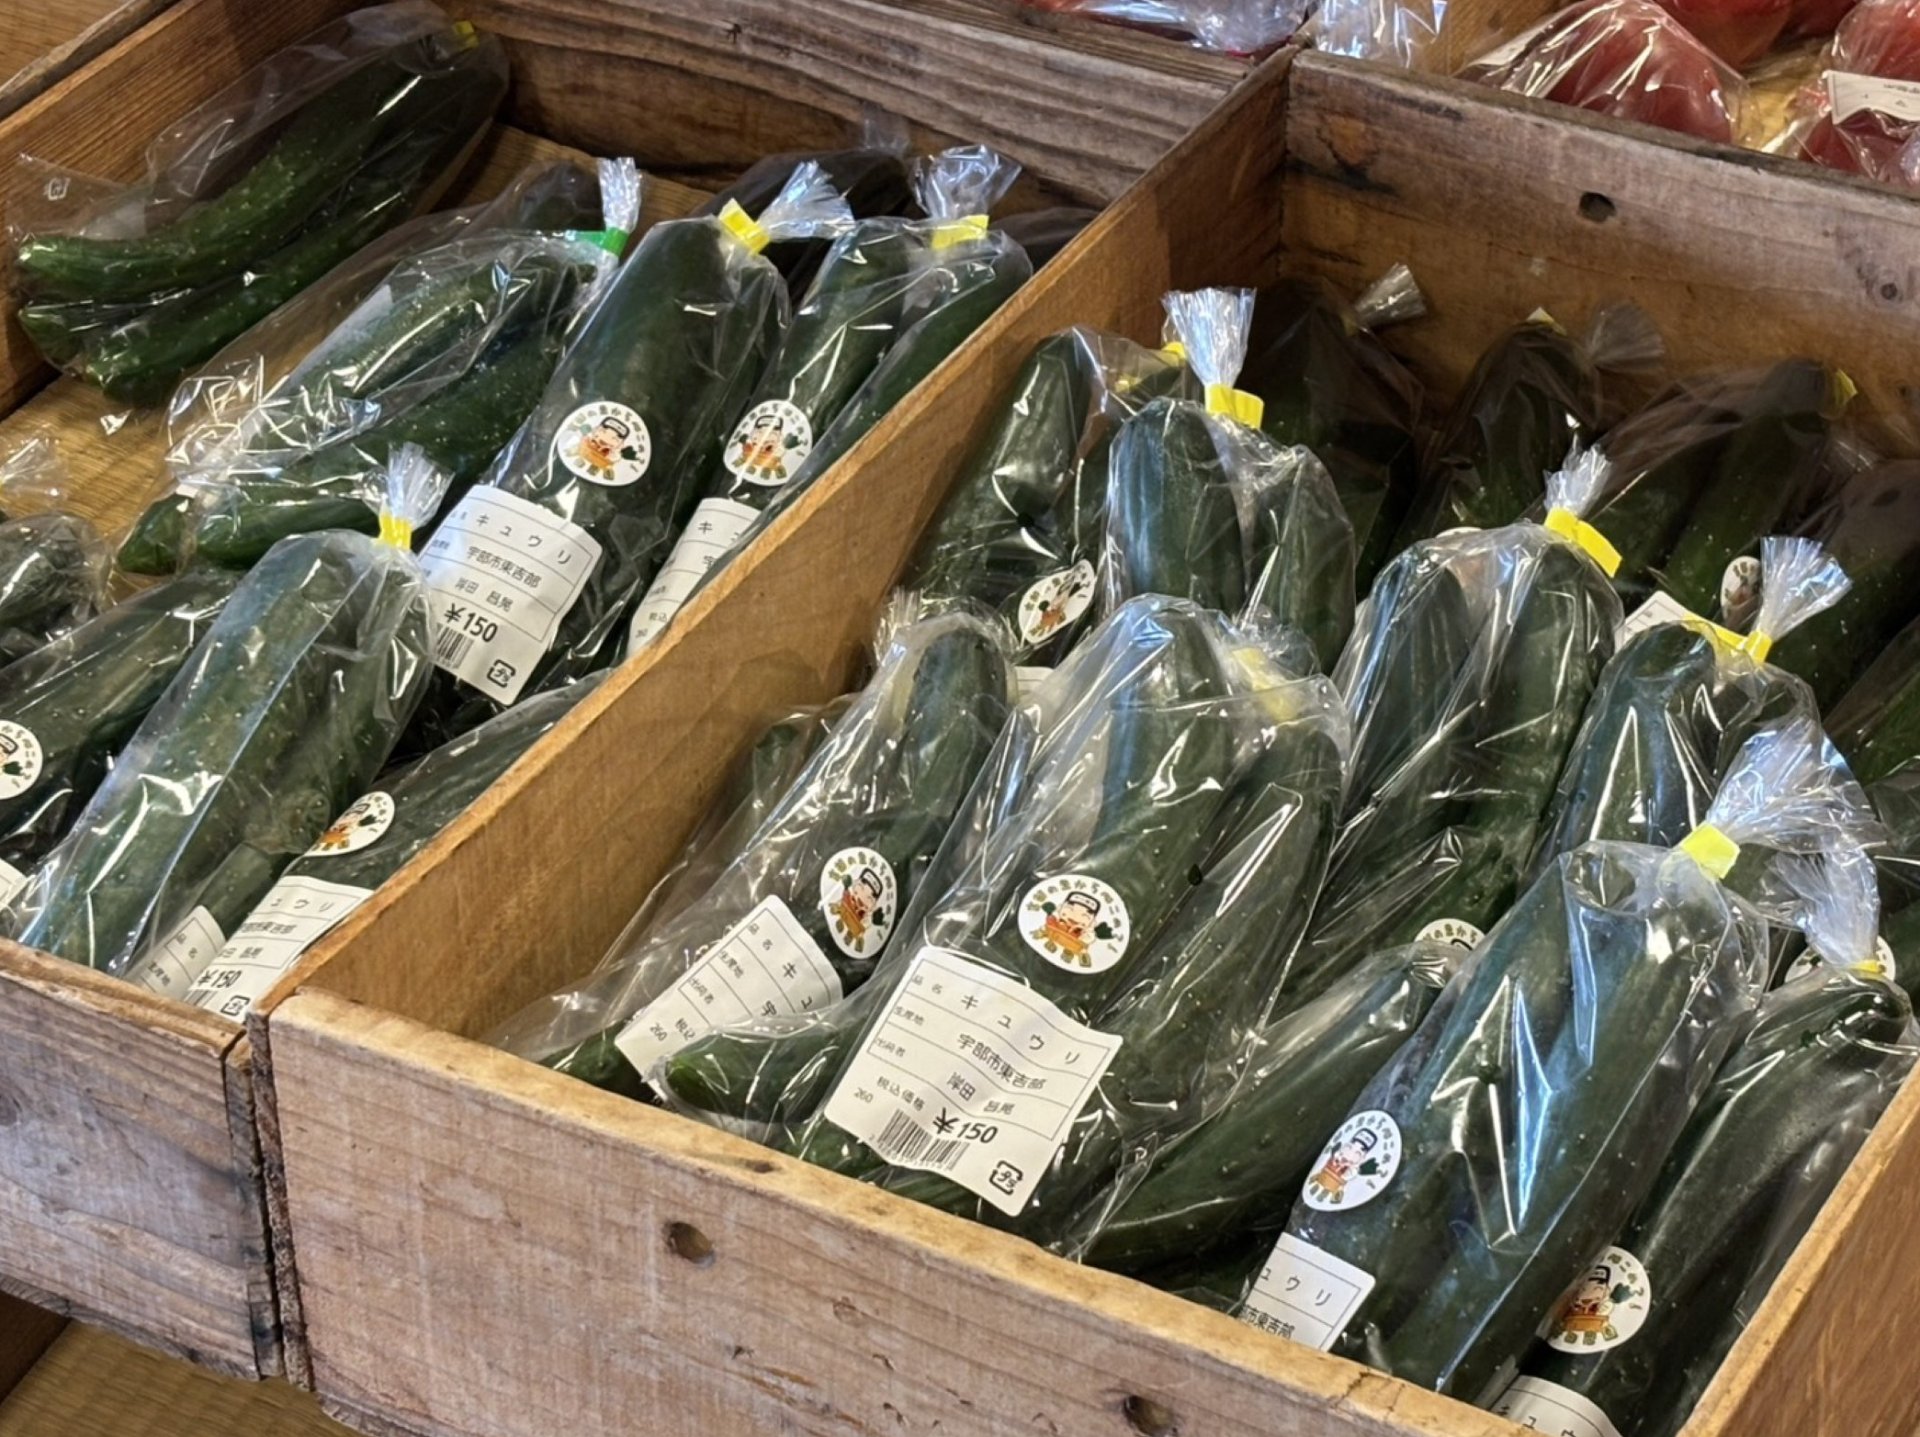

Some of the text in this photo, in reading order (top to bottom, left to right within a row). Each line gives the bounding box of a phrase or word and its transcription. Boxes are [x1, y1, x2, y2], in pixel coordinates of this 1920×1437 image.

[476, 513, 572, 565] キュウリ
[443, 602, 499, 643] ¥150
[960, 994, 1081, 1065] キュウリ
[957, 1033, 1048, 1091] 宇部市東吉部
[853, 1086, 874, 1104] 260
[932, 1107, 999, 1145] ¥150
[1241, 1304, 1296, 1340] 市東吉部
